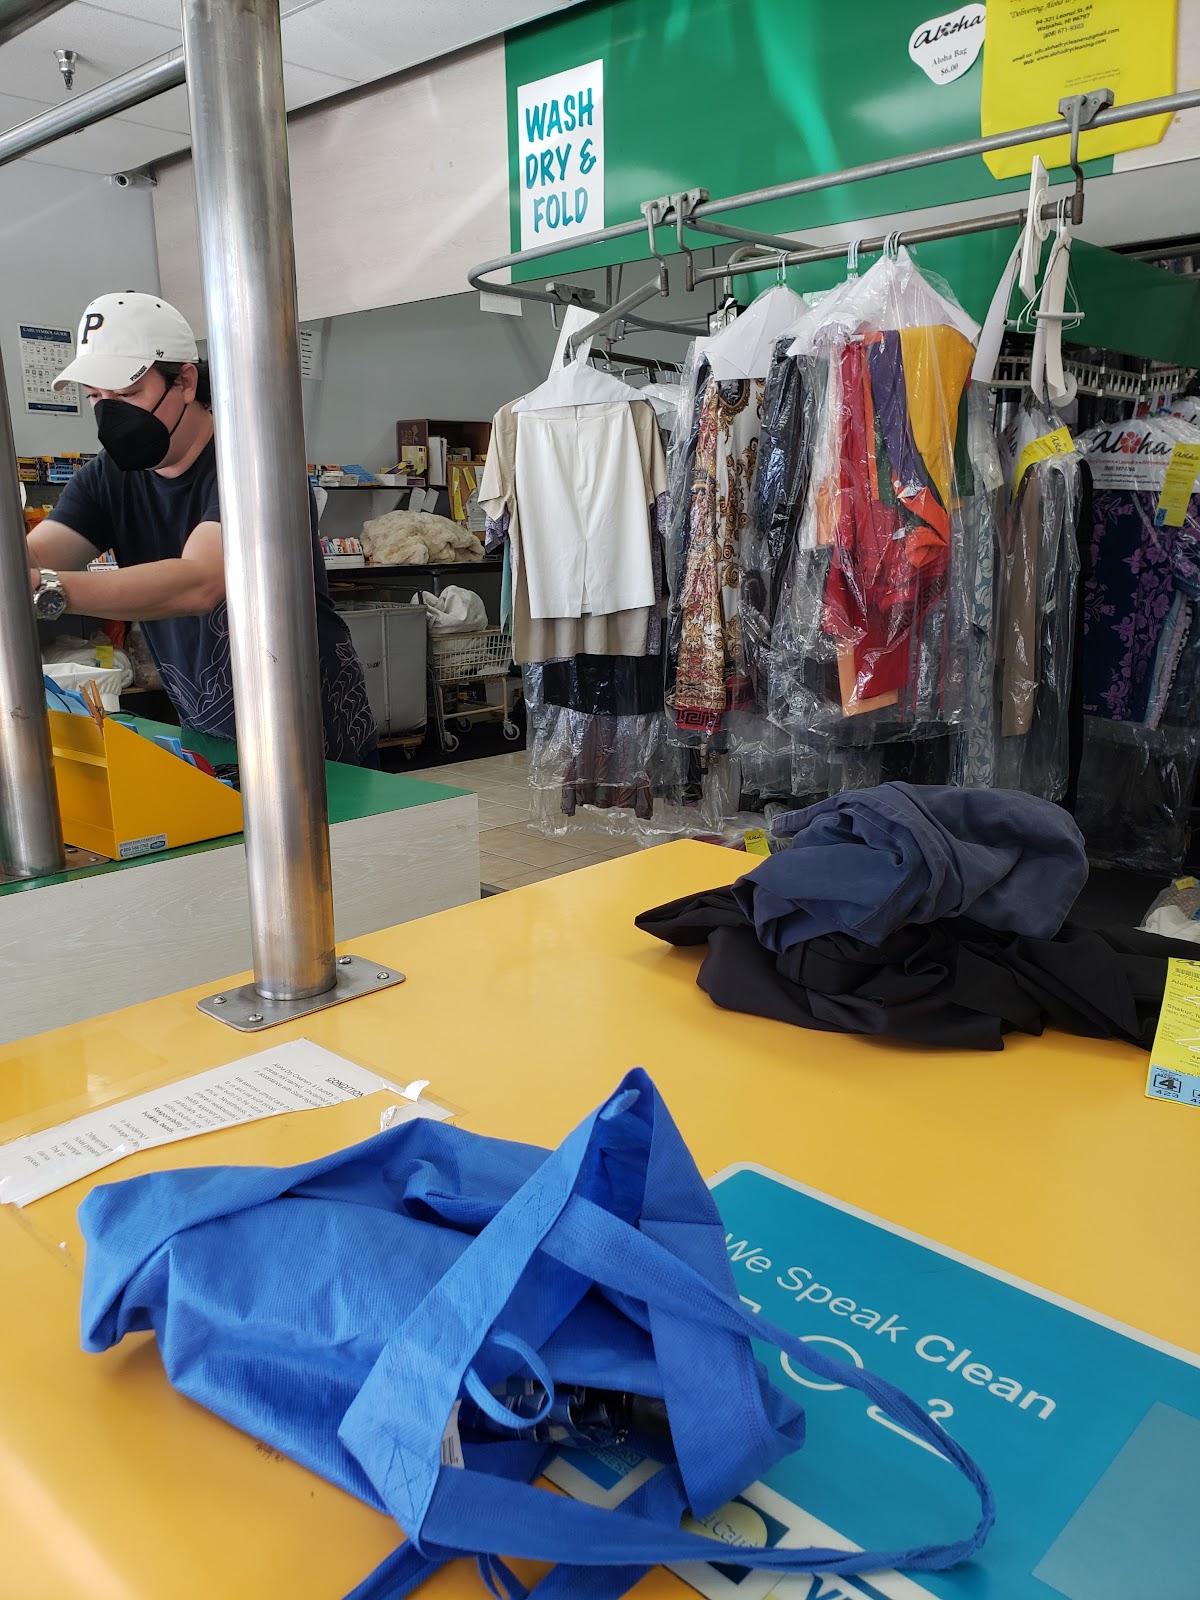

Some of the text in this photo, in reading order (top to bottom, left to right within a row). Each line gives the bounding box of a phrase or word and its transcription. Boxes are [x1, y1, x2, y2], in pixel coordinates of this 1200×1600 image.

[1035, 16, 1054, 25] 94-321
[1037, 22, 1063, 32] Waipahu,
[1072, 13, 1090, 22] 96797
[1043, 30, 1056, 39] (808)
[932, 48, 967, 66] Aloha Bag
[1012, 54, 1025, 62] email
[940, 63, 959, 76] $6.00
[525, 88, 594, 142] WASH
[525, 138, 597, 189] DRY &
[533, 187, 589, 233] FOLD
[81, 313, 105, 344] P
[1171, 979, 1193, 989] Aloha
[258, 1073, 283, 1086] accordance
[272, 1063, 286, 1071] Aloha
[292, 1073, 313, 1085] Cleaners
[315, 1086, 335, 1097] Laundry
[1159, 1079, 1177, 1091] 4
[242, 1082, 260, 1092] exercise
[259, 1092, 276, 1101] utmost
[304, 1089, 330, 1102] Unclaimed
[1156, 1090, 1179, 1098] 423
[249, 1105, 264, 1113] nature
[153, 1107, 184, 1127] Responsibility
[725, 1233, 1057, 1420] We Speak Clean
